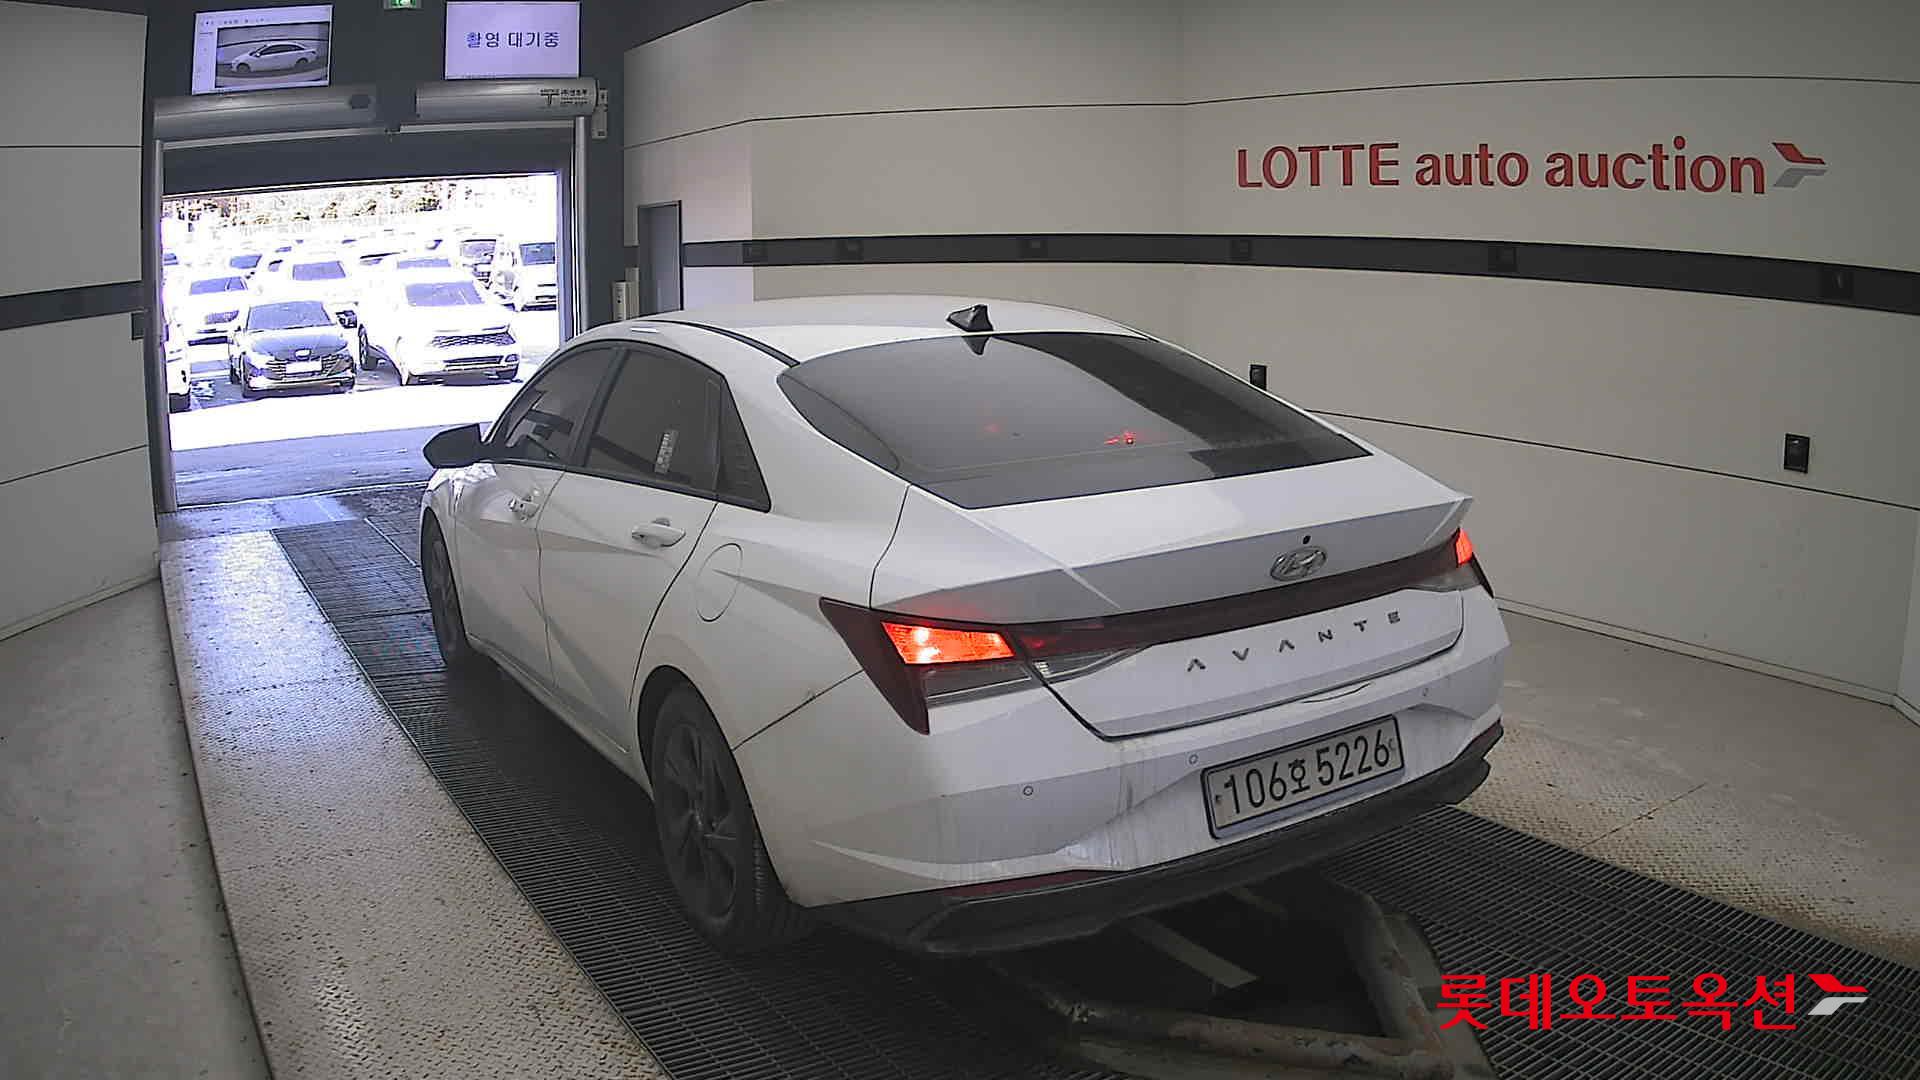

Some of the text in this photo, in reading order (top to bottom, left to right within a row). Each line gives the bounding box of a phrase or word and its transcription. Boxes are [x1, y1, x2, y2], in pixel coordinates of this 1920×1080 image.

[507, 31, 560, 49] 대기중
[1236, 135, 1765, 194] LOTTE auto auction
[1187, 610, 1401, 673] AVANTE
